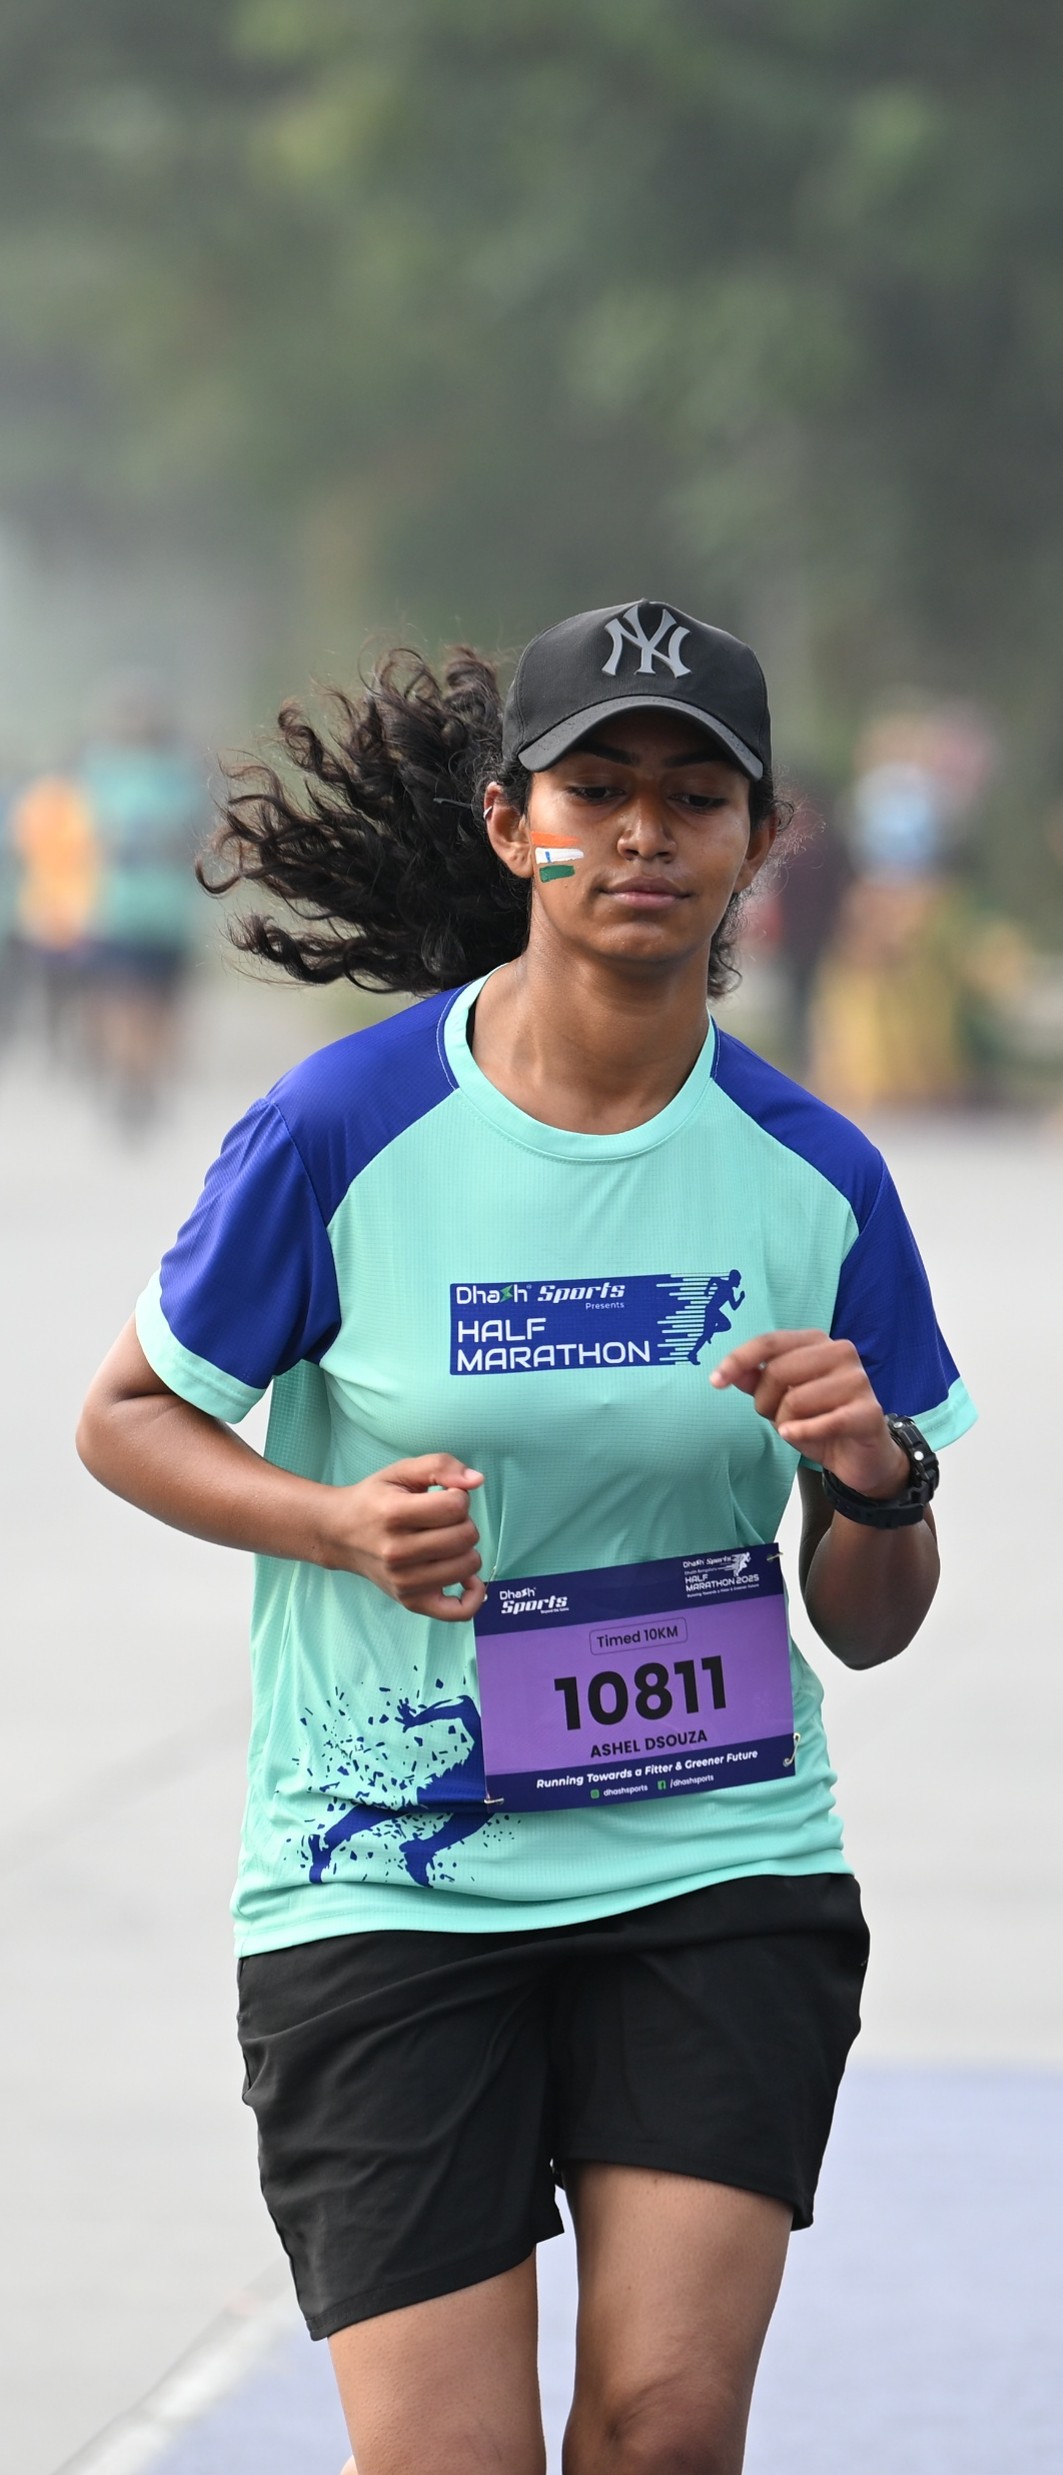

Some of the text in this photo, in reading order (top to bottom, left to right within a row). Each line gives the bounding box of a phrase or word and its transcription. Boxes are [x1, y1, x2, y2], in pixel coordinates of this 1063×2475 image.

[601, 604, 692, 678] NY
[537, 1282, 625, 1304] Sports
[585, 1302, 625, 1310] Presents
[457, 1317, 547, 1343] HALF
[457, 1340, 650, 1372] MARATHON
[685, 1573, 708, 1584] HALF
[685, 1578, 735, 1592] MARATHON
[736, 1573, 760, 1585] 2025
[501, 1595, 568, 1615] Sports
[596, 1625, 679, 1648] Timed 10KM
[554, 1655, 727, 1731] 10811
[590, 1729, 708, 1758] ASHEL DSOUZA
[536, 1750, 758, 1789] Running Towards a Fitter & Greener Future
[603, 1784, 648, 1797] dhashsports
